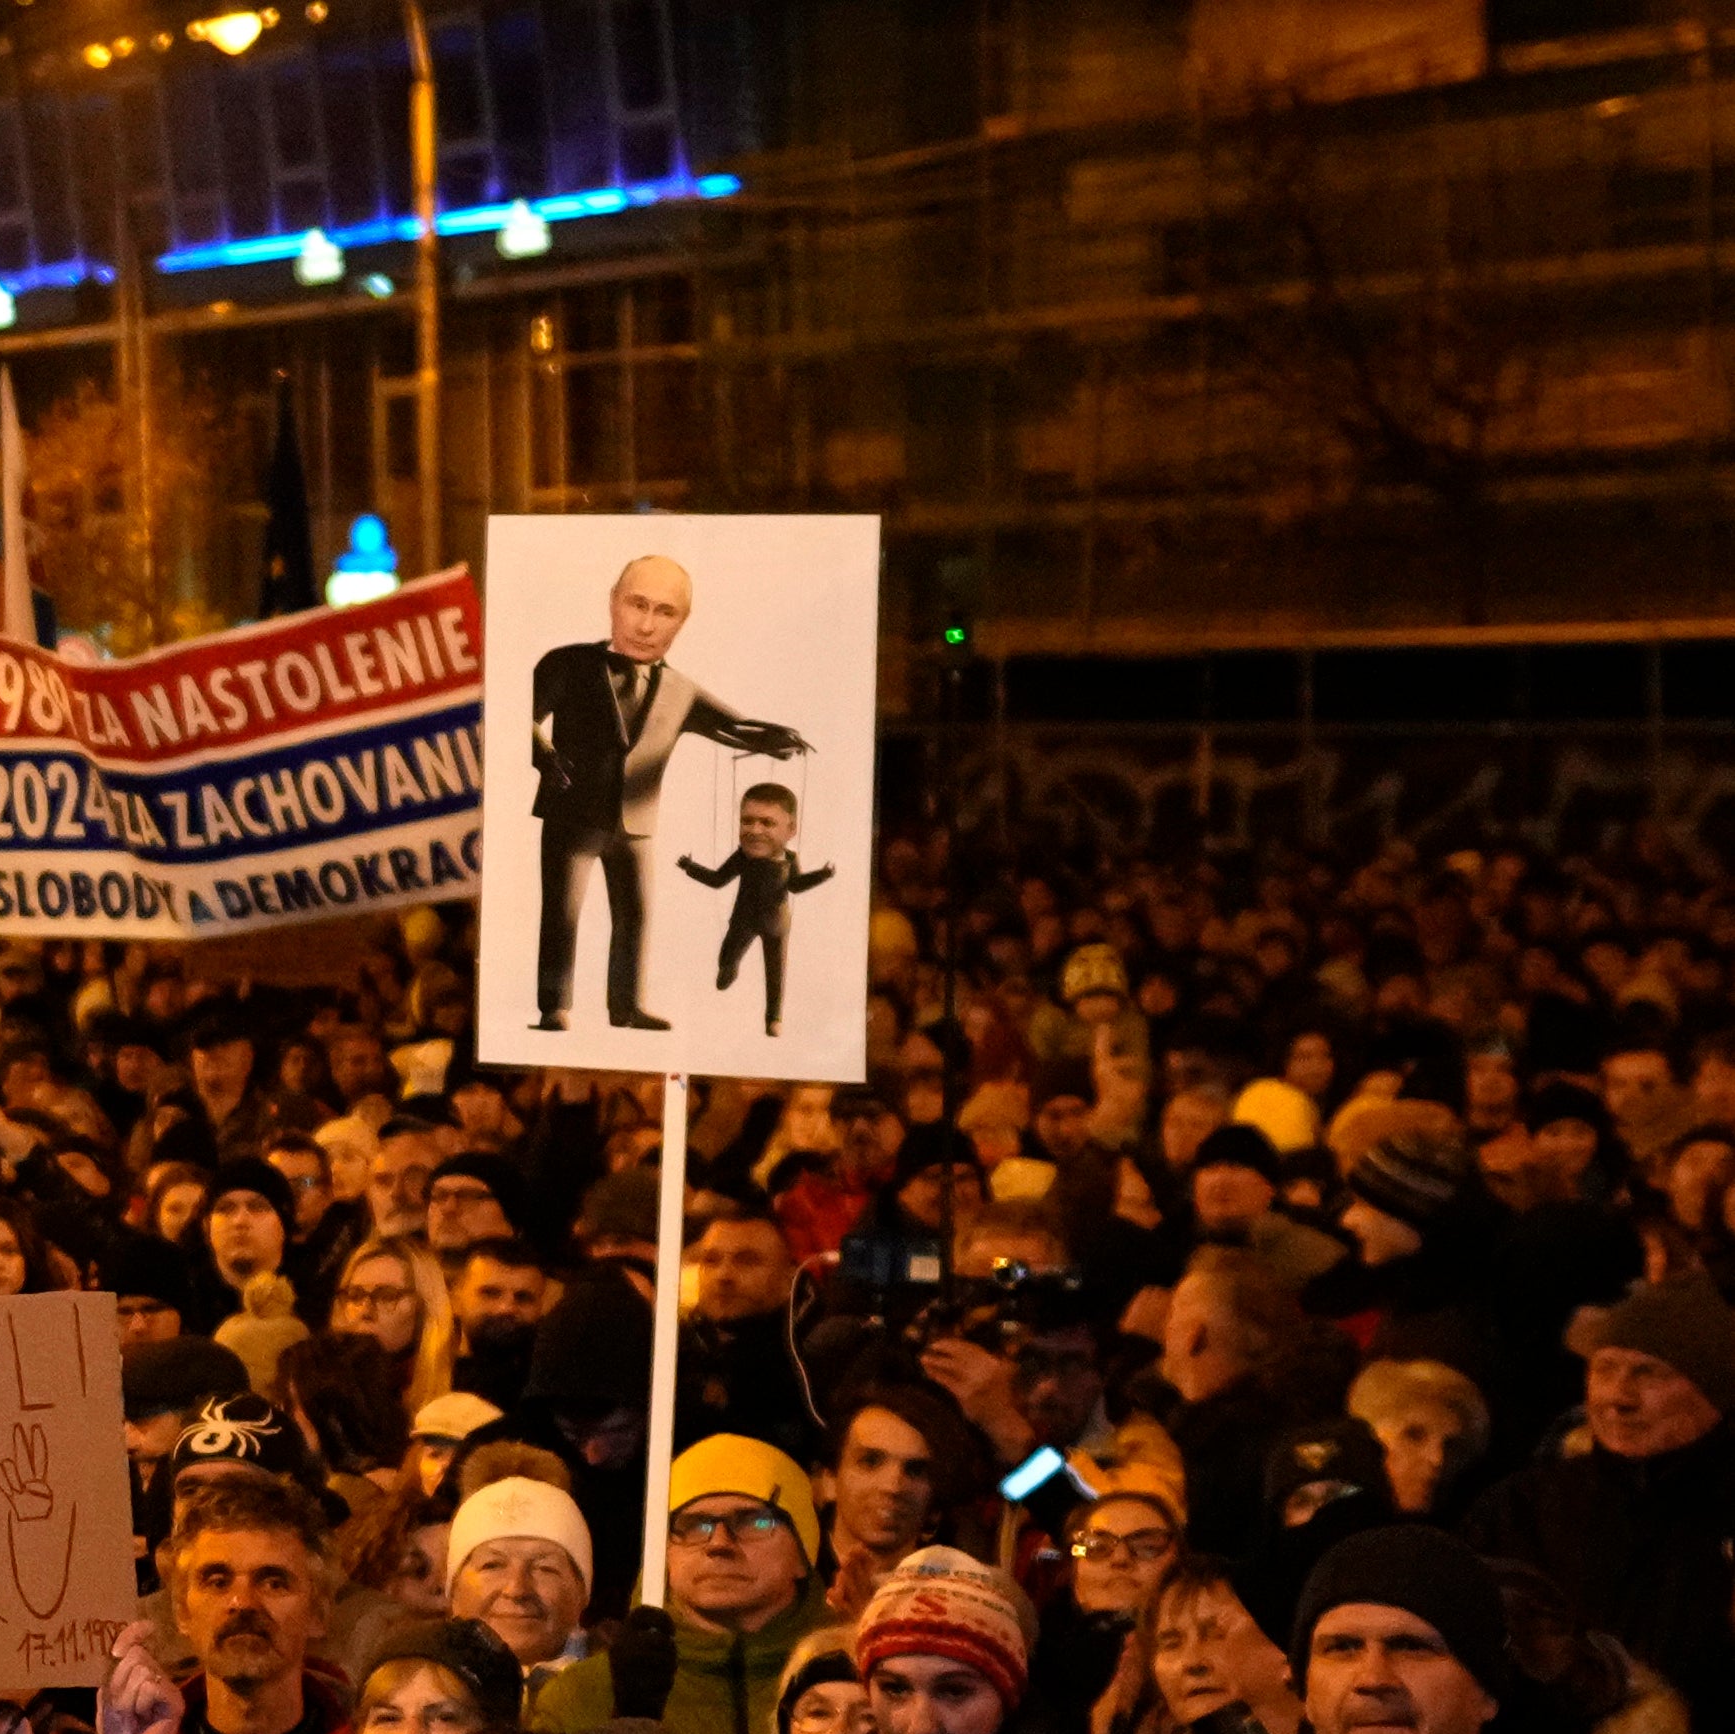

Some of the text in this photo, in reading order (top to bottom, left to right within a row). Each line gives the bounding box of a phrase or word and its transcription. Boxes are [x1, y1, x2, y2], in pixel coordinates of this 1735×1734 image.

[74, 689, 131, 748] ZA
[128, 606, 479, 750] NASTOLENIE
[112, 789, 166, 849] ZA
[161, 719, 484, 852] ZACHOVANI
